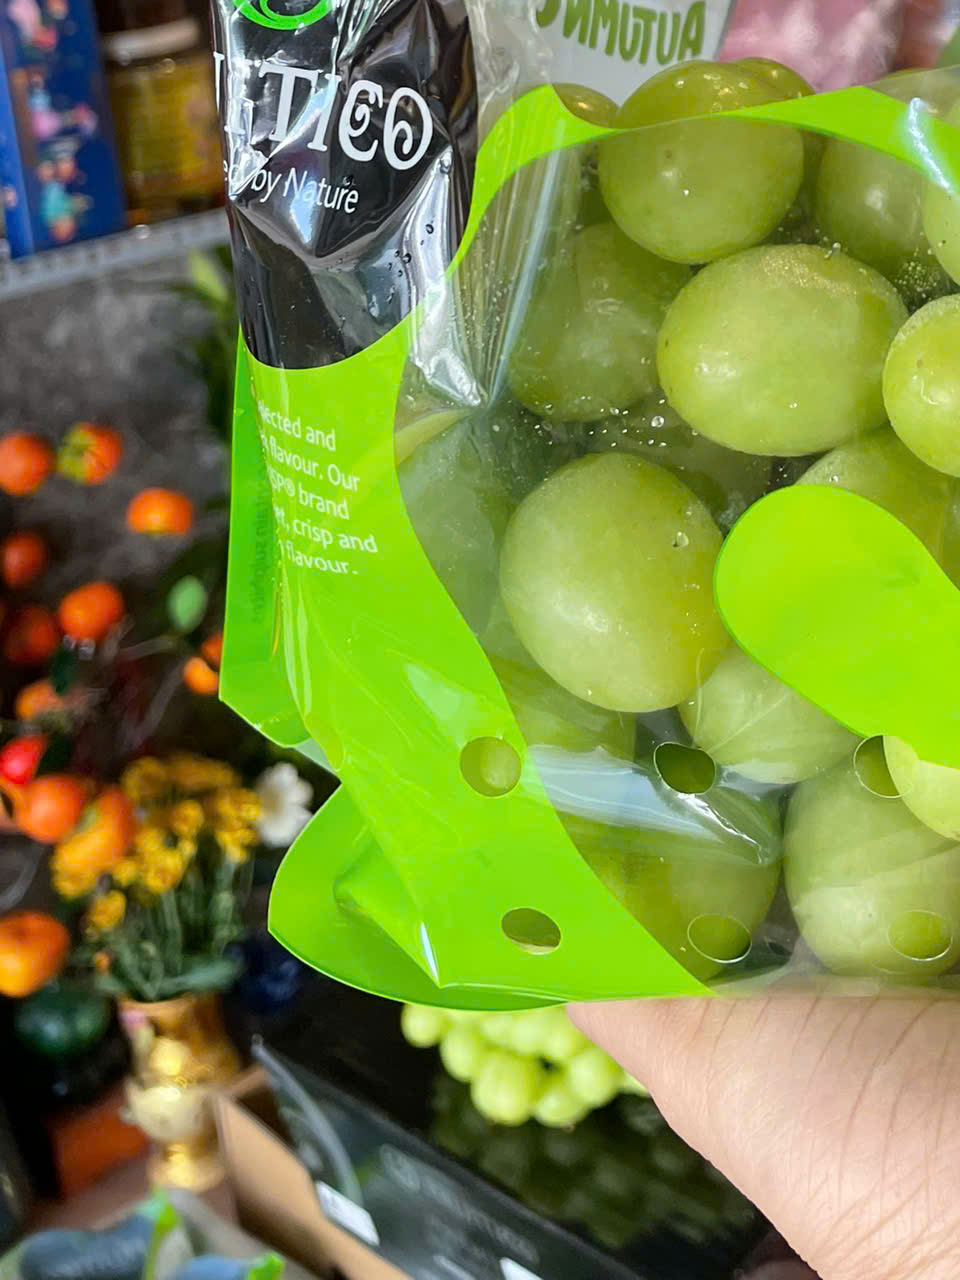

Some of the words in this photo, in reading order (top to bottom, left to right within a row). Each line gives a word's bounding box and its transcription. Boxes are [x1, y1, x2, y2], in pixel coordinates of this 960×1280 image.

[283, 167, 359, 214] Nature
[306, 425, 337, 453] and
[327, 463, 361, 493] Our
[298, 481, 350, 521] brand
[293, 518, 334, 550] crisp
[338, 532, 379, 554] and
[285, 538, 361, 576] flavour.
